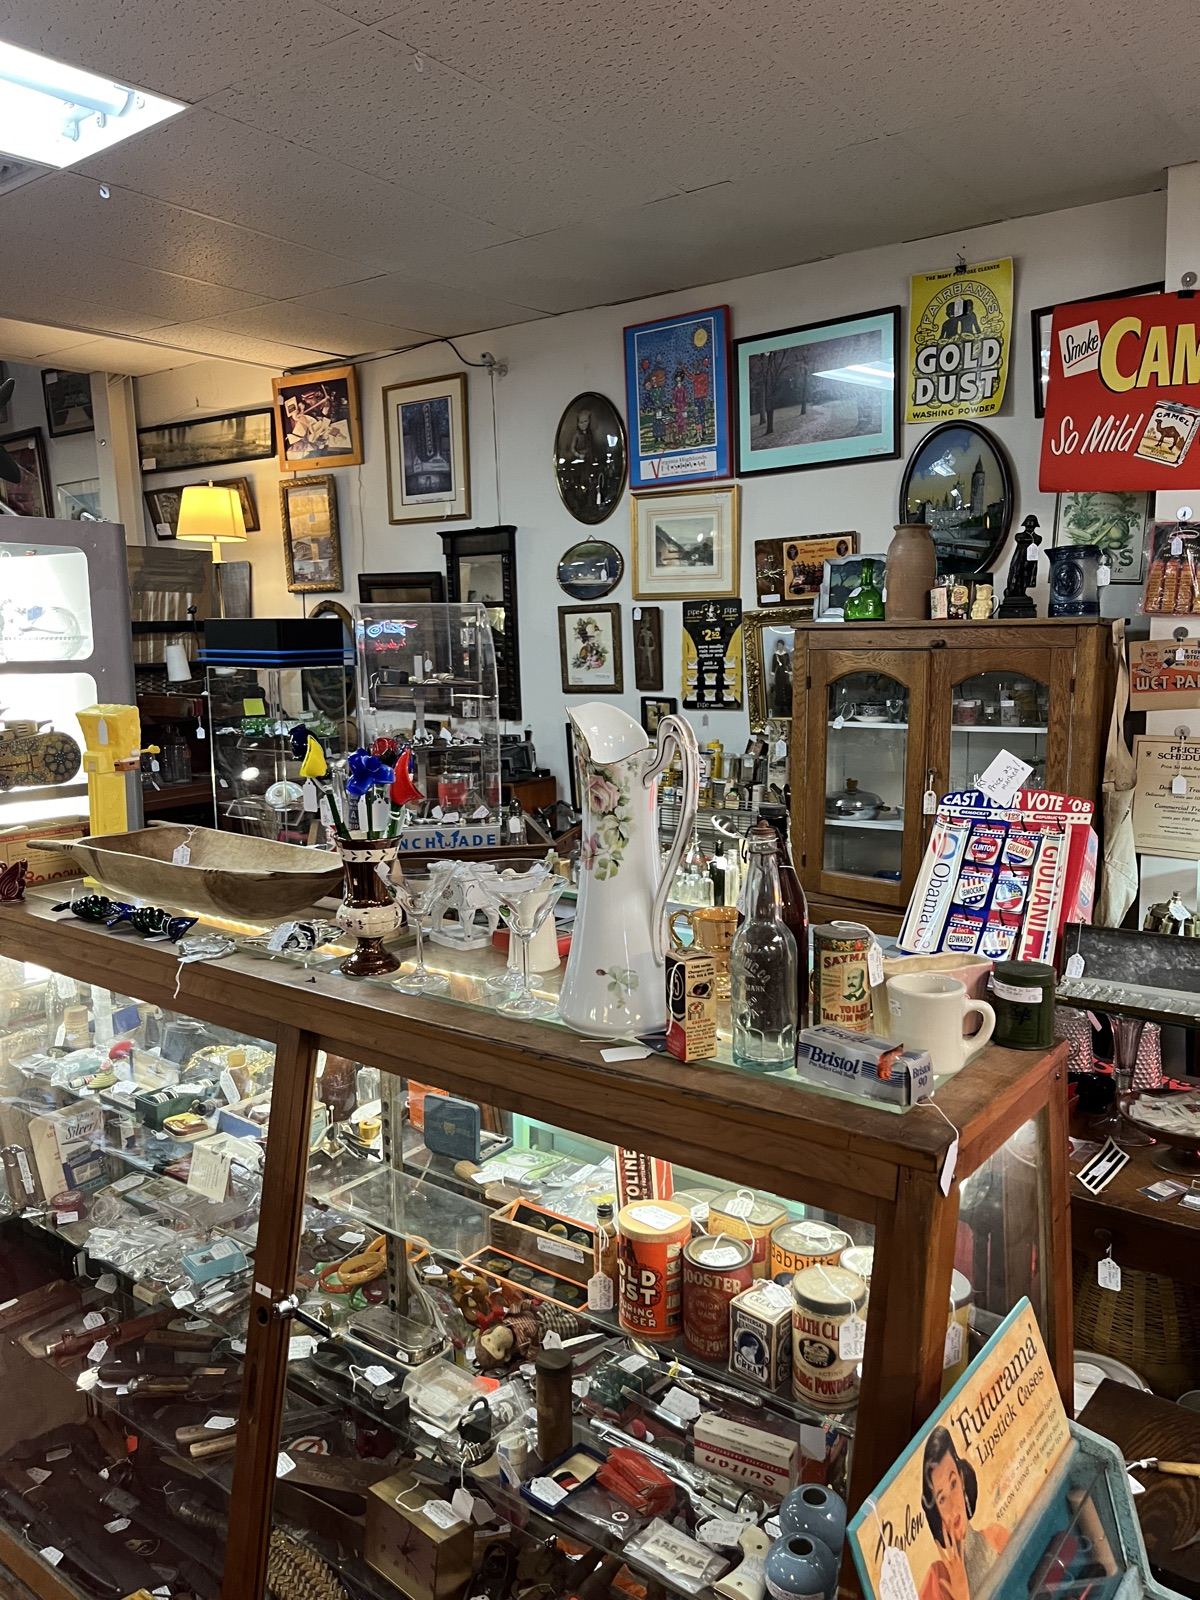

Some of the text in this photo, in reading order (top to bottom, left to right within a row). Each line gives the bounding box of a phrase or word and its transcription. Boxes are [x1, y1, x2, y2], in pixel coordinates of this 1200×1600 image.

[923, 283, 998, 324] FAIRBANKS
[916, 338, 1000, 374] GOLD
[1063, 328, 1099, 364] Smoke
[914, 369, 998, 406] DUST
[912, 404, 995, 419] WASHING POWDER
[1156, 412, 1190, 426] CAMEL
[1051, 413, 1144, 456] So Mild
[1136, 675, 1170, 690] WET
[943, 792, 978, 807] CAST
[1027, 791, 1065, 811] VOTE
[972, 843, 995, 852] CLINTON
[920, 863, 951, 924] Obama
[1025, 846, 1058, 931] GIULIANI
[949, 935, 974, 944] EDWARDS
[823, 952, 868, 968] SAYMA
[821, 1007, 853, 1022] TALCUM
[839, 1003, 868, 1014] TOILET
[809, 1046, 860, 1075] Bristol
[912, 1062, 931, 1079] Bristol
[617, 1258, 657, 1287] OLD
[619, 1275, 657, 1305] UST
[620, 1307, 657, 1328] ANSER
[621, 1301, 654, 1318] URING
[793, 1312, 840, 1341] EALTH CL
[736, 1353, 765, 1379] CREAM
[975, 1404, 1018, 1466] Lipstick
[1017, 1365, 1045, 1407] Cases
[705, 1455, 776, 1487] Sultan
